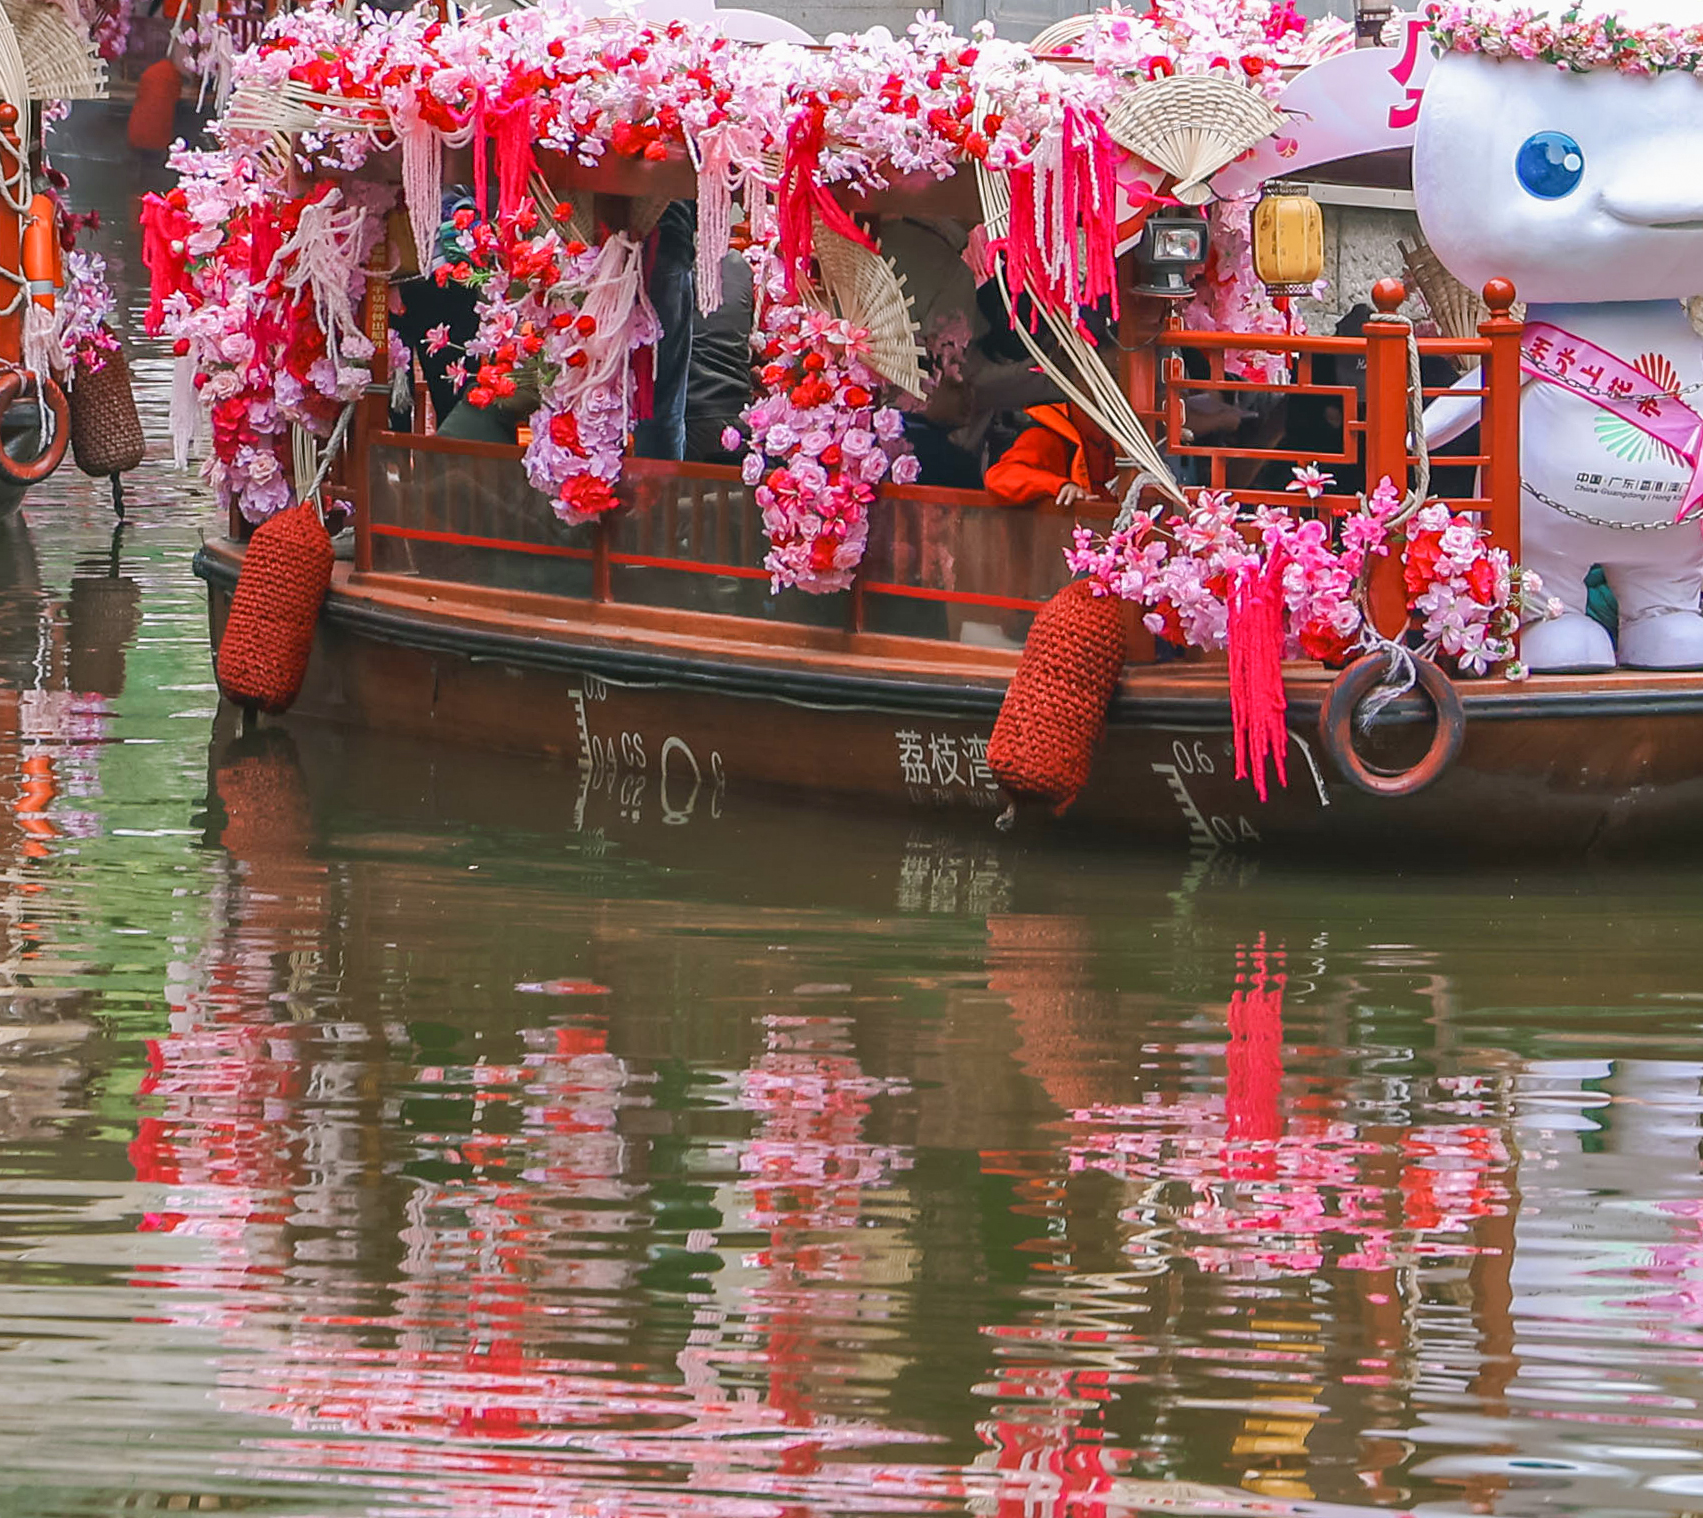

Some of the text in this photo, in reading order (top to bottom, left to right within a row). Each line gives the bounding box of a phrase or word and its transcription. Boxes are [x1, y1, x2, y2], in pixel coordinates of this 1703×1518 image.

[895, 728, 999, 790] 荔枝湾
[1173, 740, 1215, 774] 0.6
